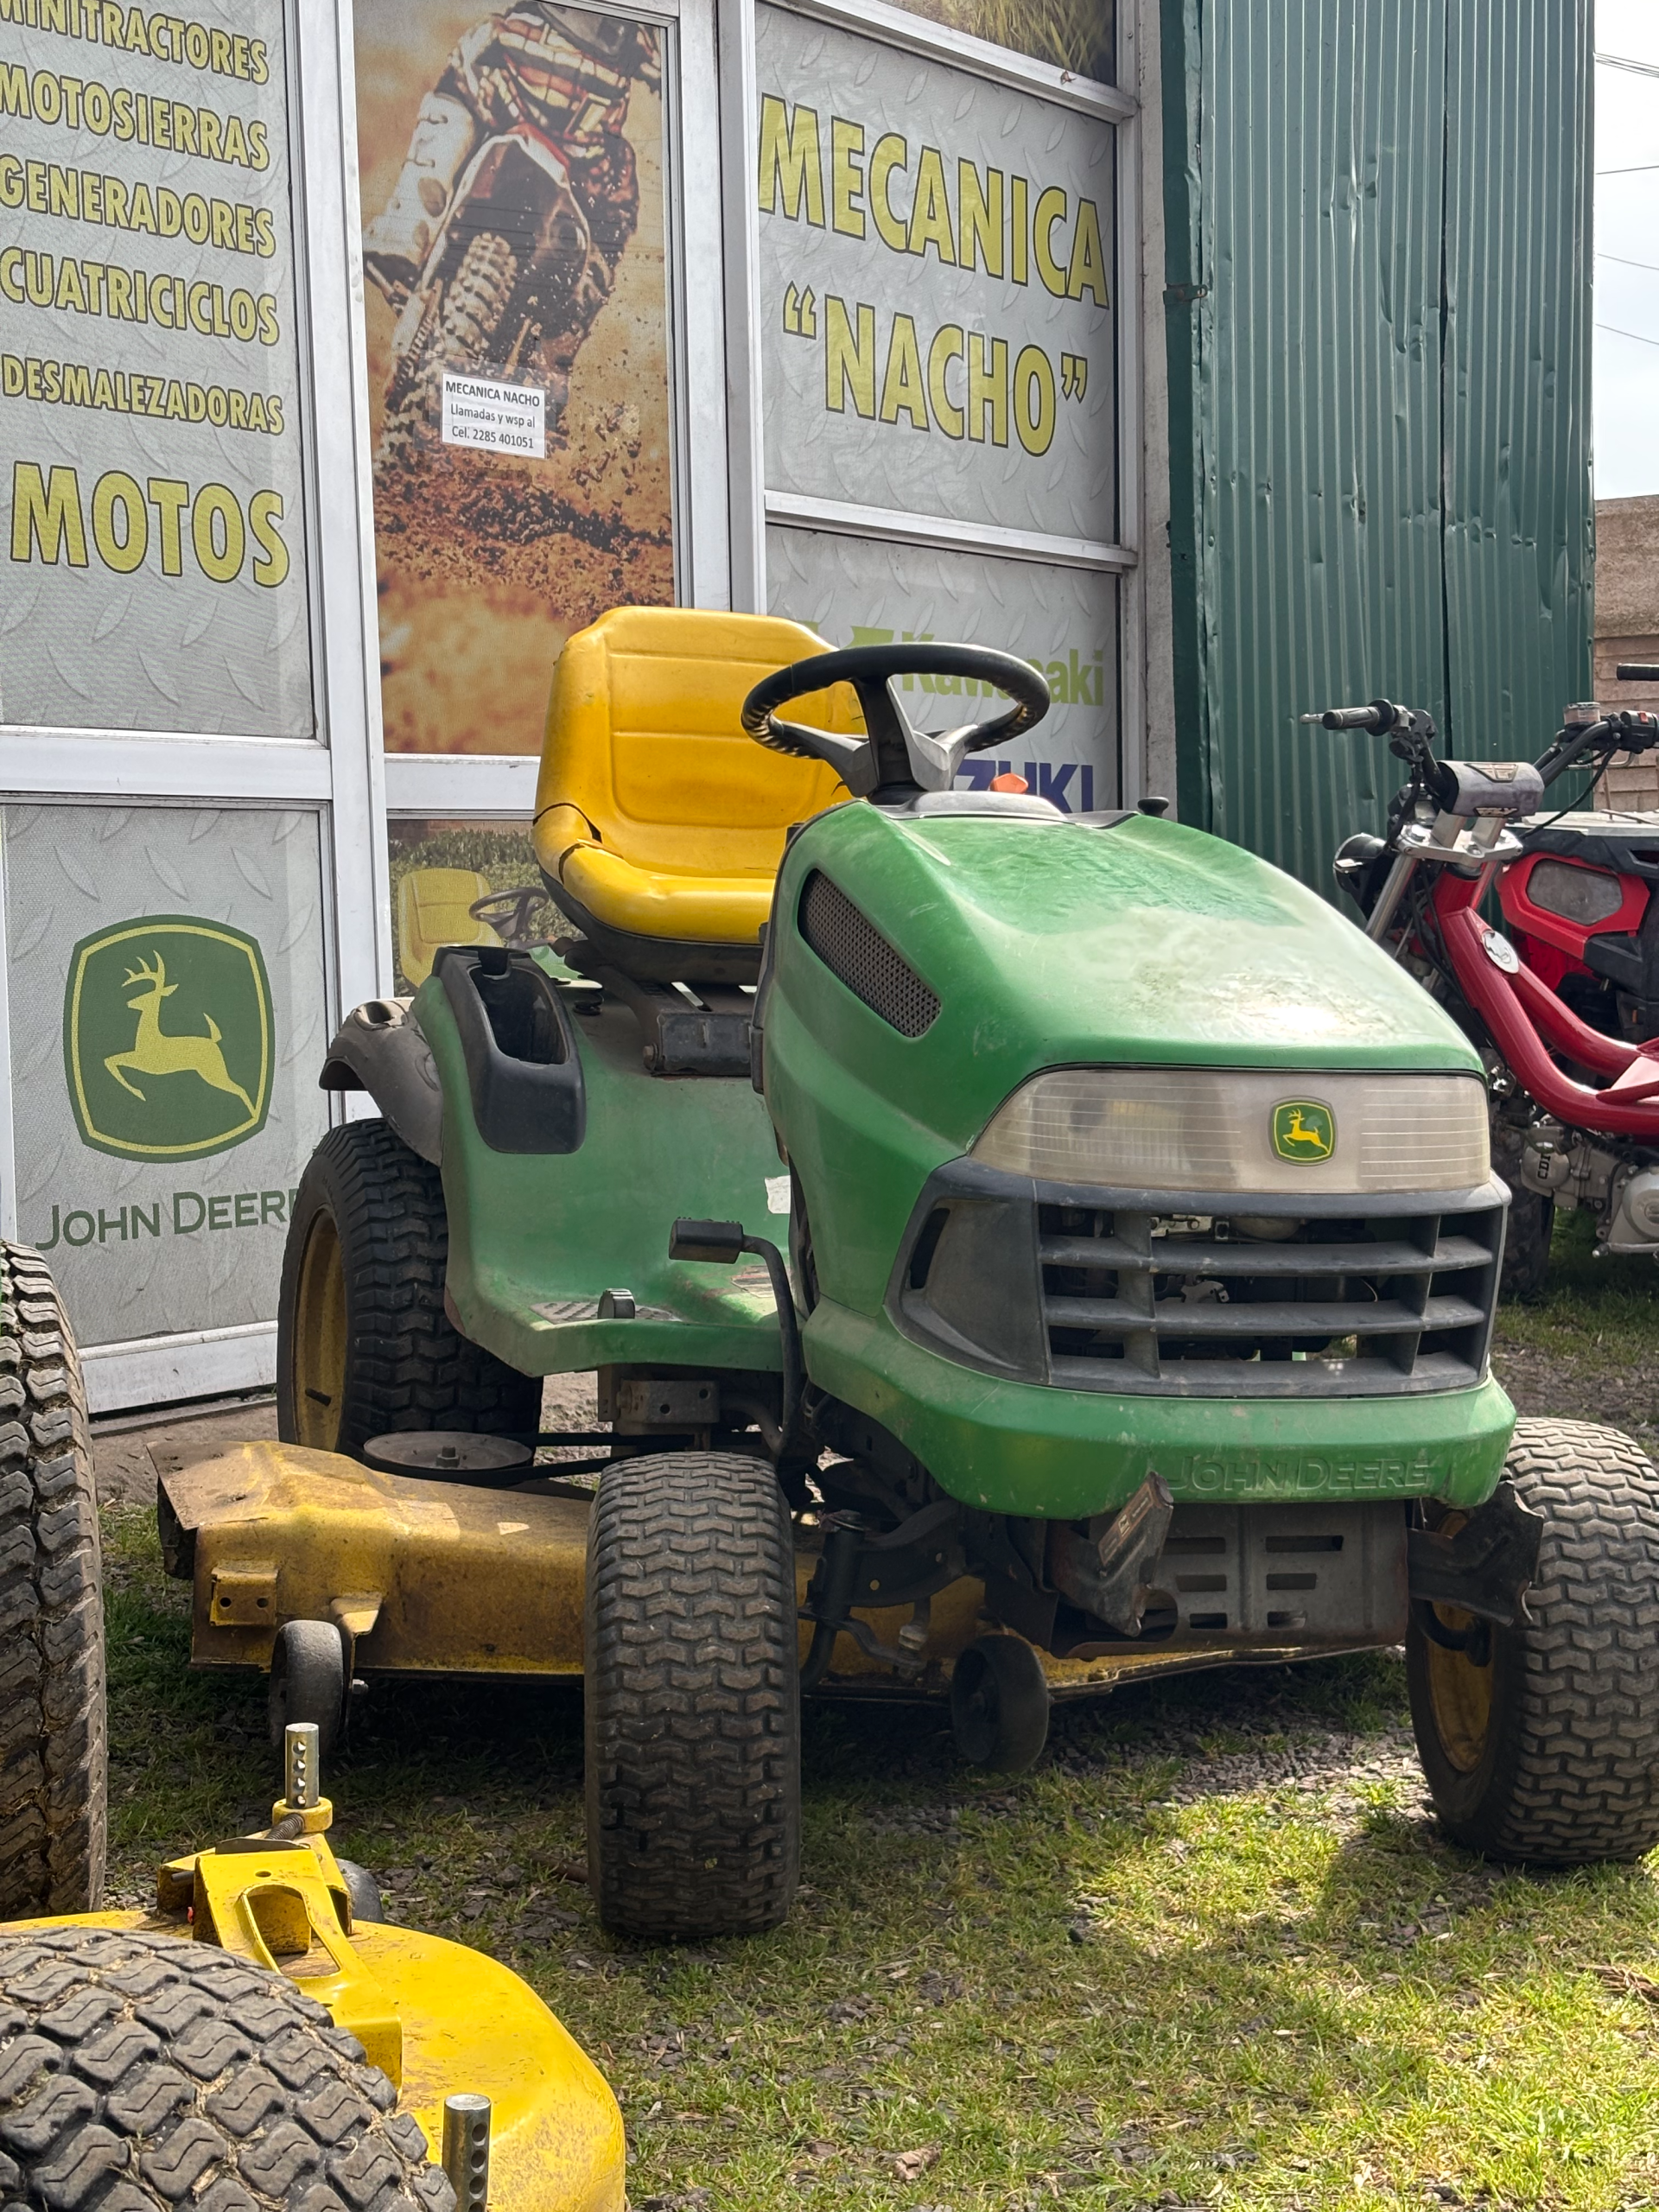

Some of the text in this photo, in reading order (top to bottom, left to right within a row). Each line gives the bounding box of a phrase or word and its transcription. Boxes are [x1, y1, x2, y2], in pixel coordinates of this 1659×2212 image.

[0, 61, 270, 172] MOTOSIERRAS
[0, 154, 276, 258] GENERADORES
[759, 92, 1109, 309] MECANICA
[0, 245, 280, 346] CUATRICICLOS
[2, 354, 285, 435] DESMALEZADORAS
[445, 380, 540, 407] MECANICA NACHO
[783, 281, 1088, 457] “NACHO”
[450, 404, 536, 429] Llamadas y wsp al
[452, 426, 534, 449] Cel. 2285 401051
[10, 461, 290, 588] MOTOS
[35, 1188, 299, 1251] JOHN DEER
[1166, 1455, 1429, 1491] JOHN DEERE
